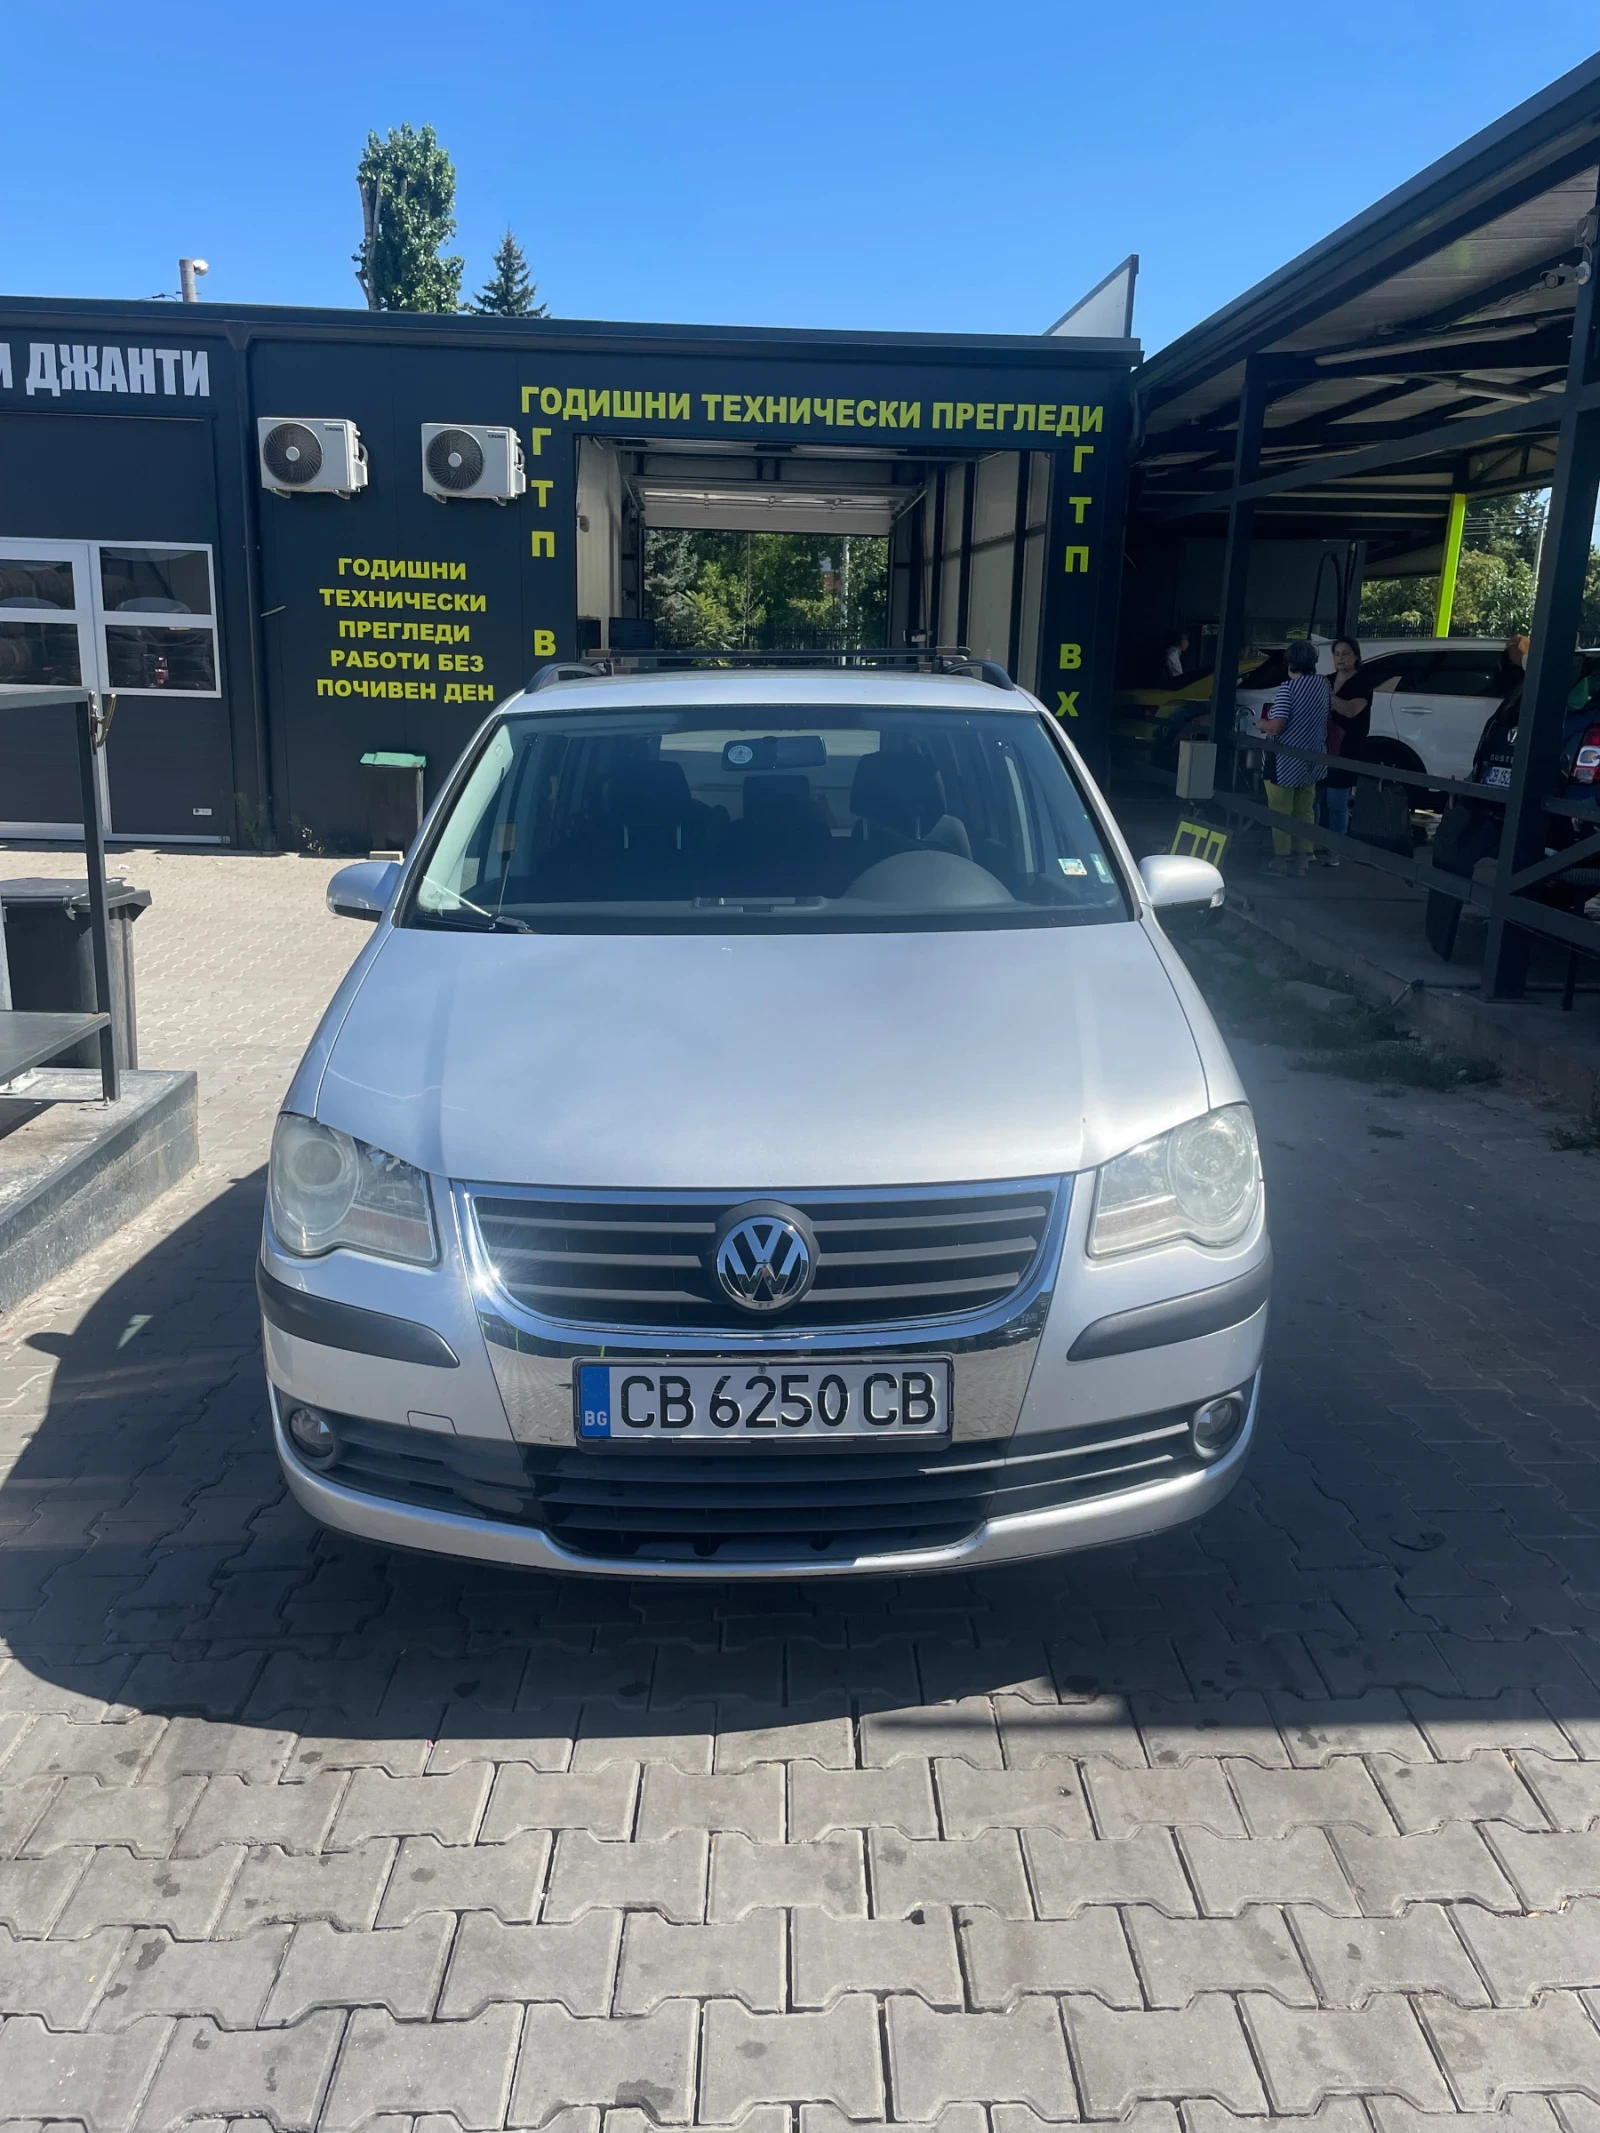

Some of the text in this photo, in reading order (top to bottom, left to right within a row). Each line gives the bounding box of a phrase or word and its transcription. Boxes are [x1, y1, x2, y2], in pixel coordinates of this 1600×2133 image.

[26, 342, 210, 397] ДЖАНТИ
[521, 386, 1104, 437] ГОДИШНИ ТЕХНИЧЕСКИ ПРЕГЛЕДИ
[338, 557, 467, 581] ГОДИШНИ
[319, 588, 487, 612] ТЕХНИЧЕСКИ
[339, 620, 470, 645] ПРЕГЛЕДИ
[330, 649, 485, 673] РАБОТИ БЕЗ
[316, 679, 495, 704] ПОЧИВЕН ДЕН
[620, 1372, 938, 1429] CB 6250 CB
[584, 1410, 608, 1427] BG
